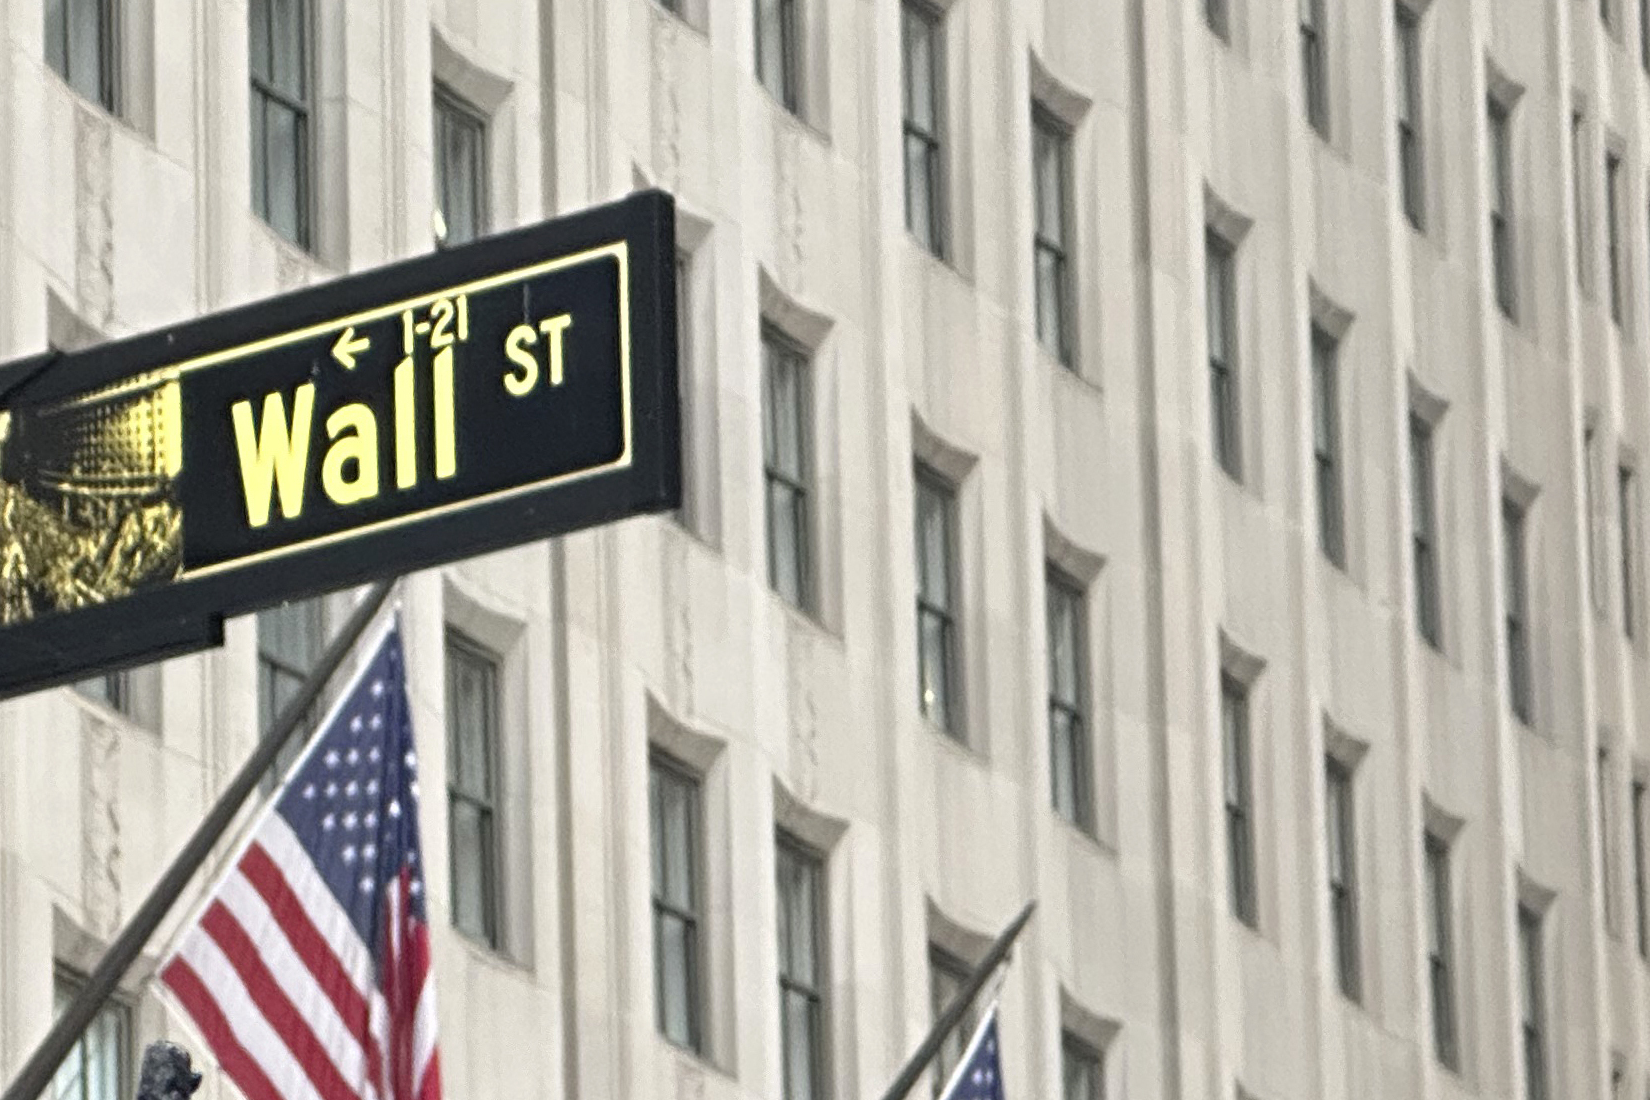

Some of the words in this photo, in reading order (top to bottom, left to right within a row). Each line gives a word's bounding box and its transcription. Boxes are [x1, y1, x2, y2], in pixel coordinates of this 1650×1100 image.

[403, 296, 466, 354] 1-21
[232, 344, 456, 527] Wall
[504, 314, 571, 396] ST
